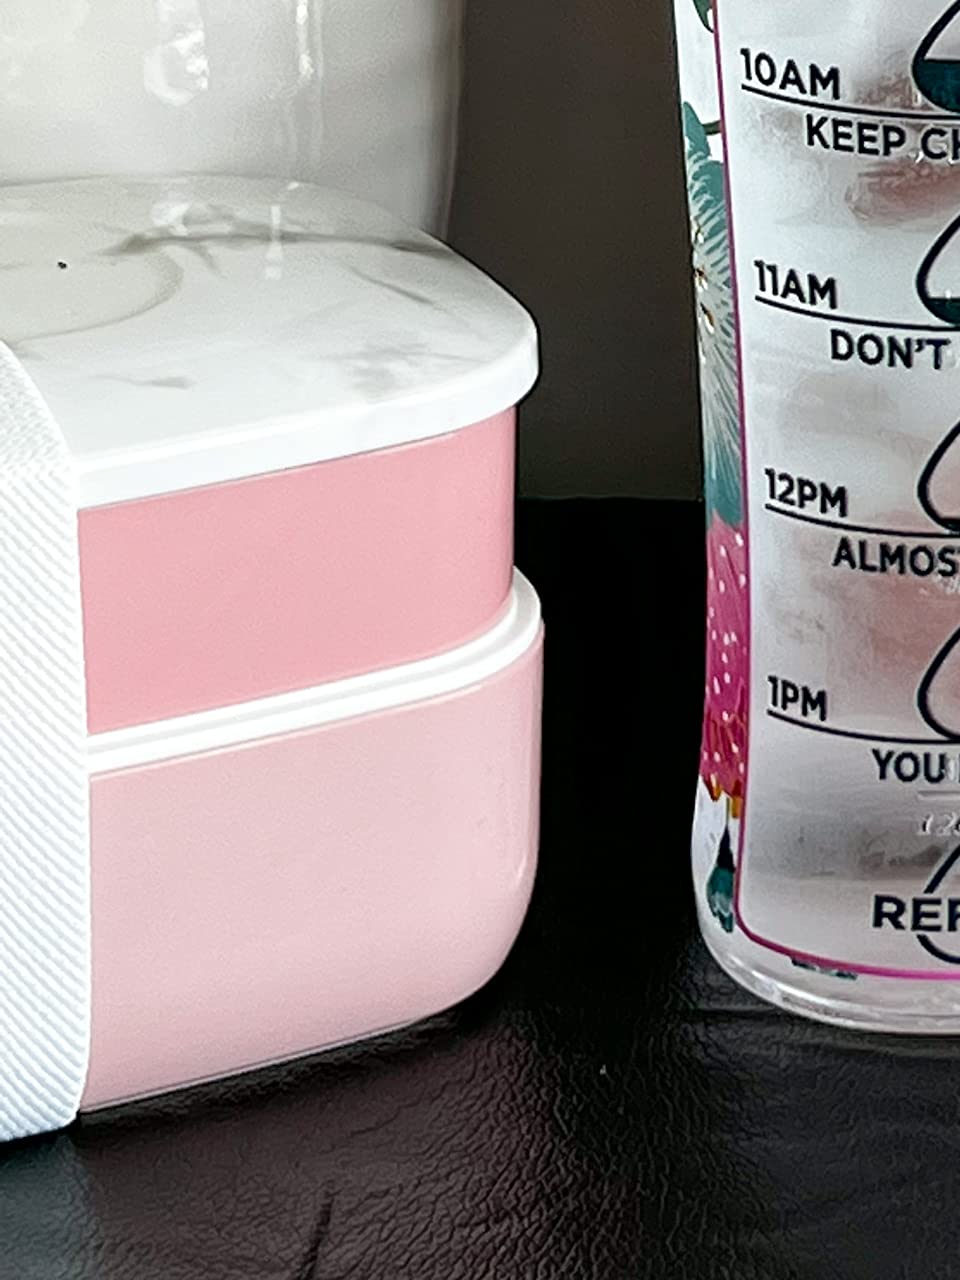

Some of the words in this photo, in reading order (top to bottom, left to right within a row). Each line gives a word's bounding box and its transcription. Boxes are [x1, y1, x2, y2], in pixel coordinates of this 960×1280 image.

[740, 48, 840, 100] 10AM
[806, 117, 907, 157] KEEP
[754, 260, 838, 309] 11AM
[831, 330, 951, 370] DON'T
[765, 468, 848, 517] 12PM
[768, 676, 827, 721] 1PM
[873, 749, 950, 783] YOU
